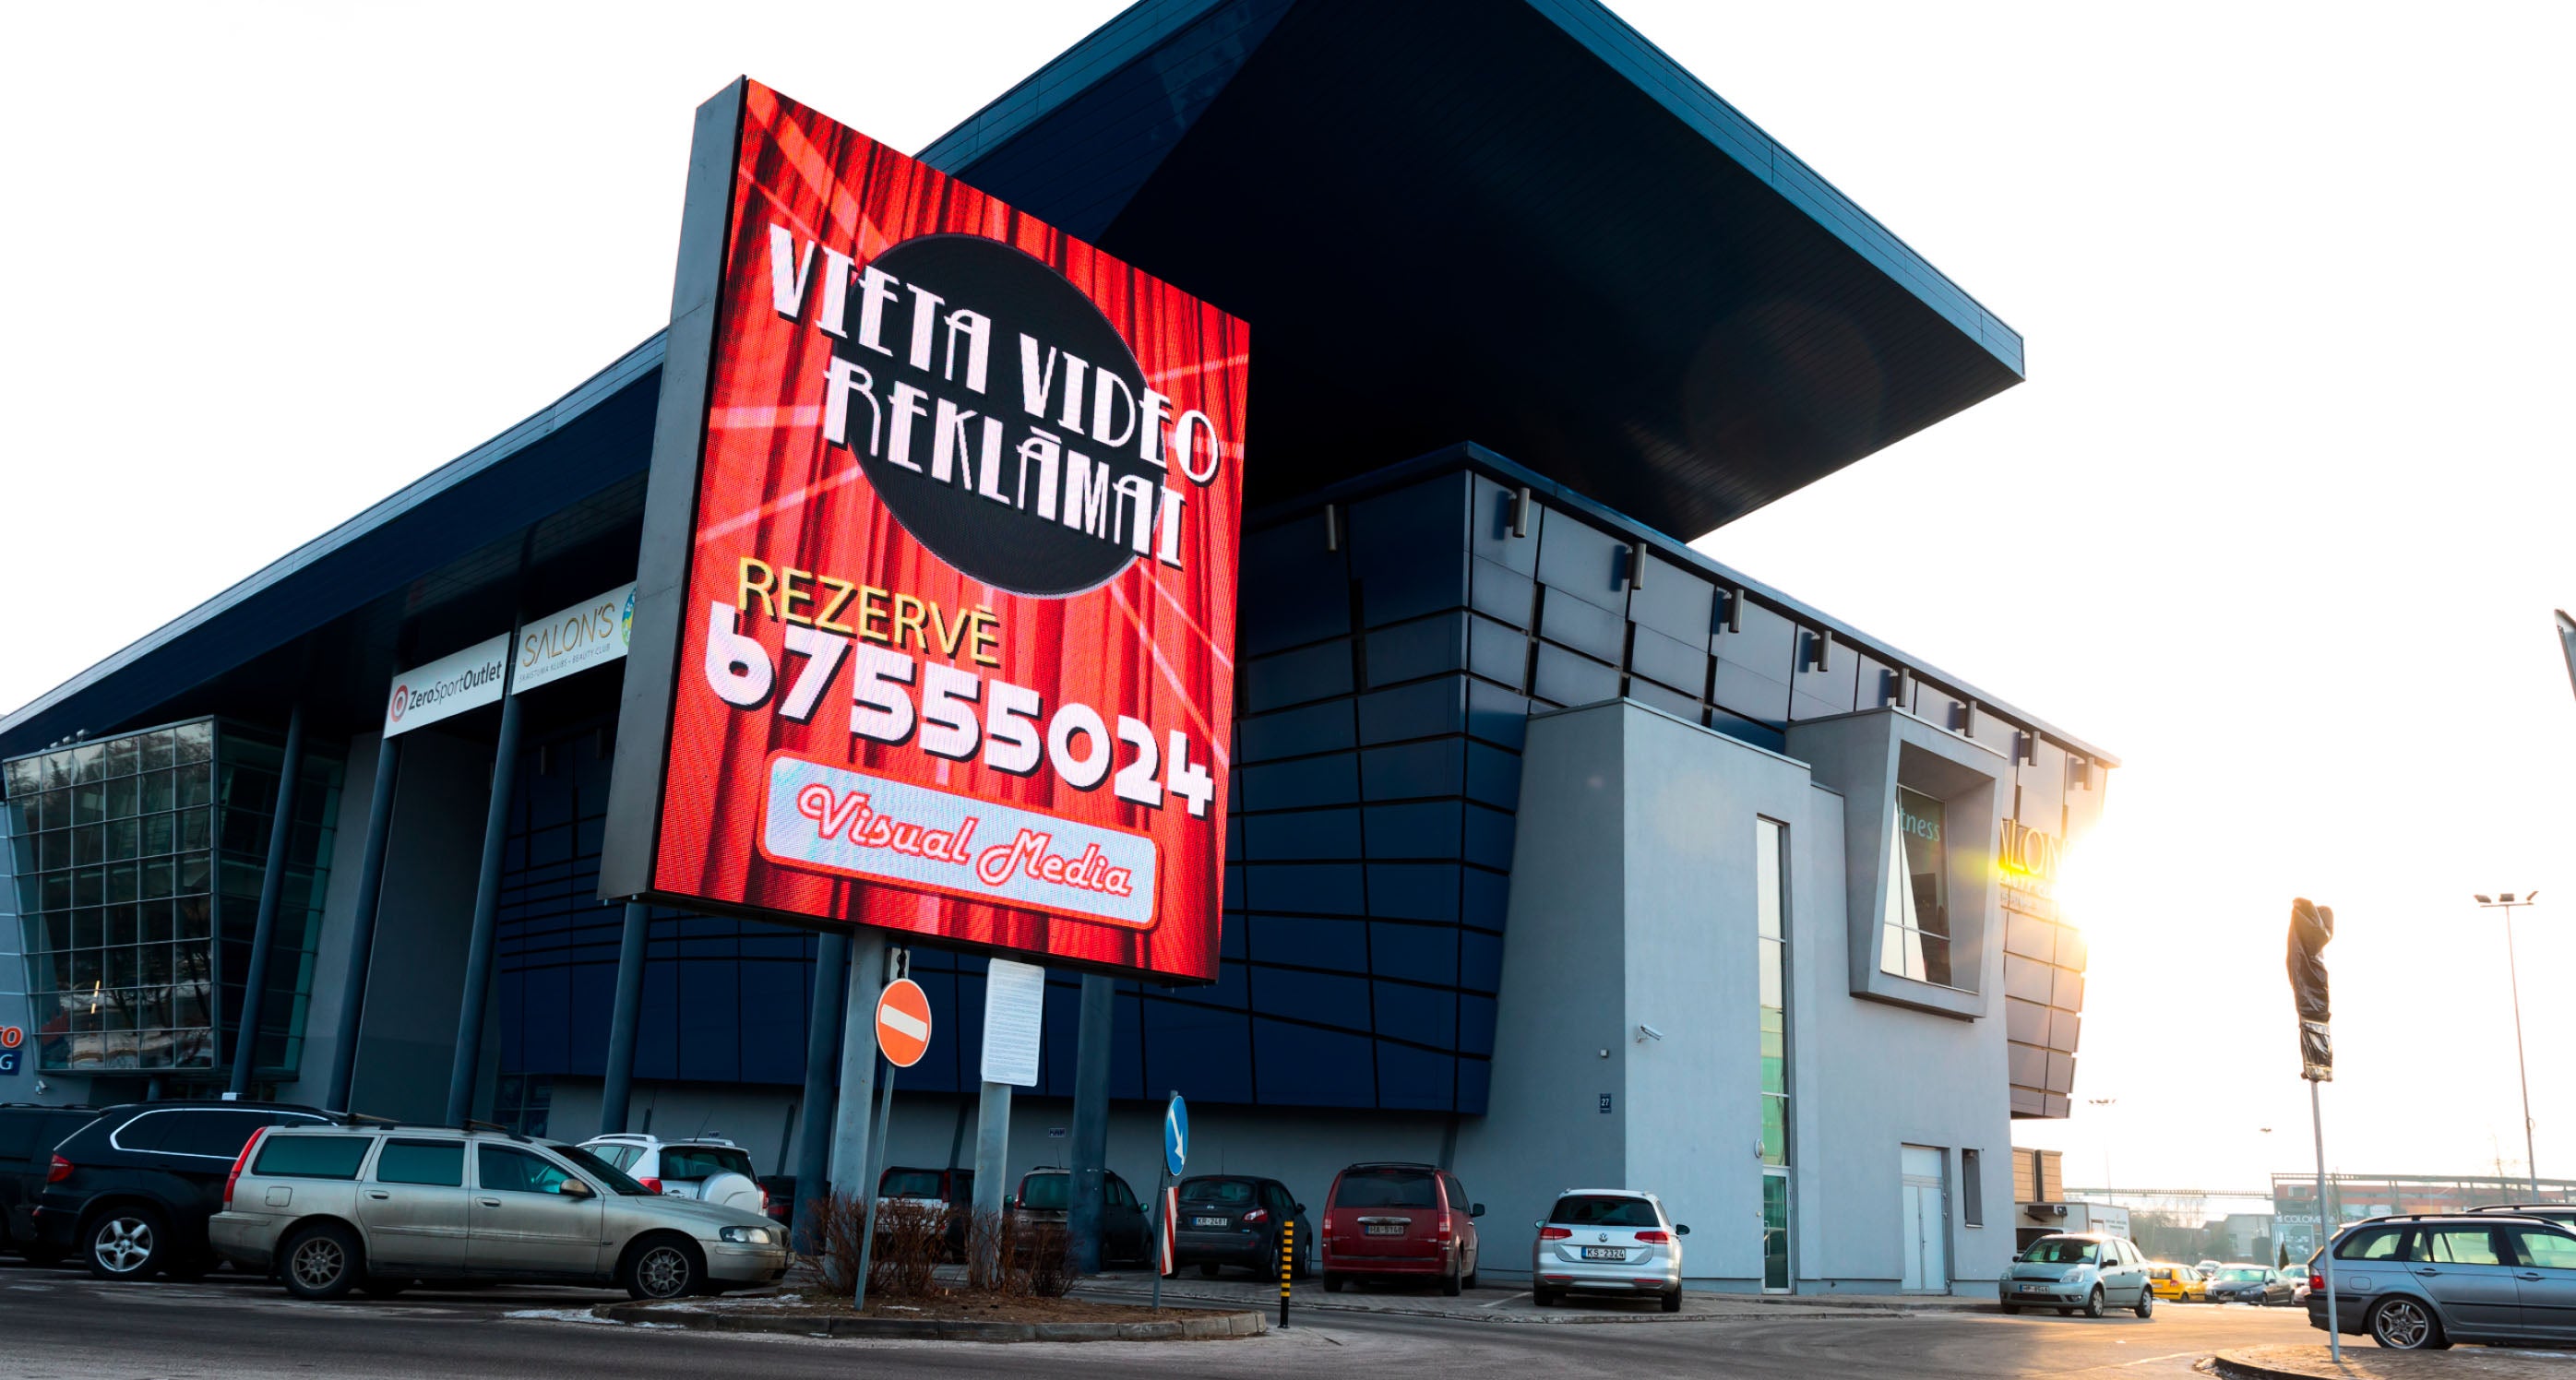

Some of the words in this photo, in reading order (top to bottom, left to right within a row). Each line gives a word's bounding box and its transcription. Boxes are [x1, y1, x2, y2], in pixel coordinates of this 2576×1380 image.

[769, 223, 991, 394] VIETA
[1020, 332, 1220, 483] VIDEO
[823, 355, 1185, 566] REKLĀMAI
[522, 602, 615, 668] SALON'S
[739, 557, 1000, 664] REZERVĒ
[409, 660, 502, 710] ZeroSportOutlet
[705, 601, 1213, 817] 67555024
[798, 782, 978, 865] Visual
[976, 828, 1134, 898] Media
[1587, 1248, 1624, 1258] KS-2324
